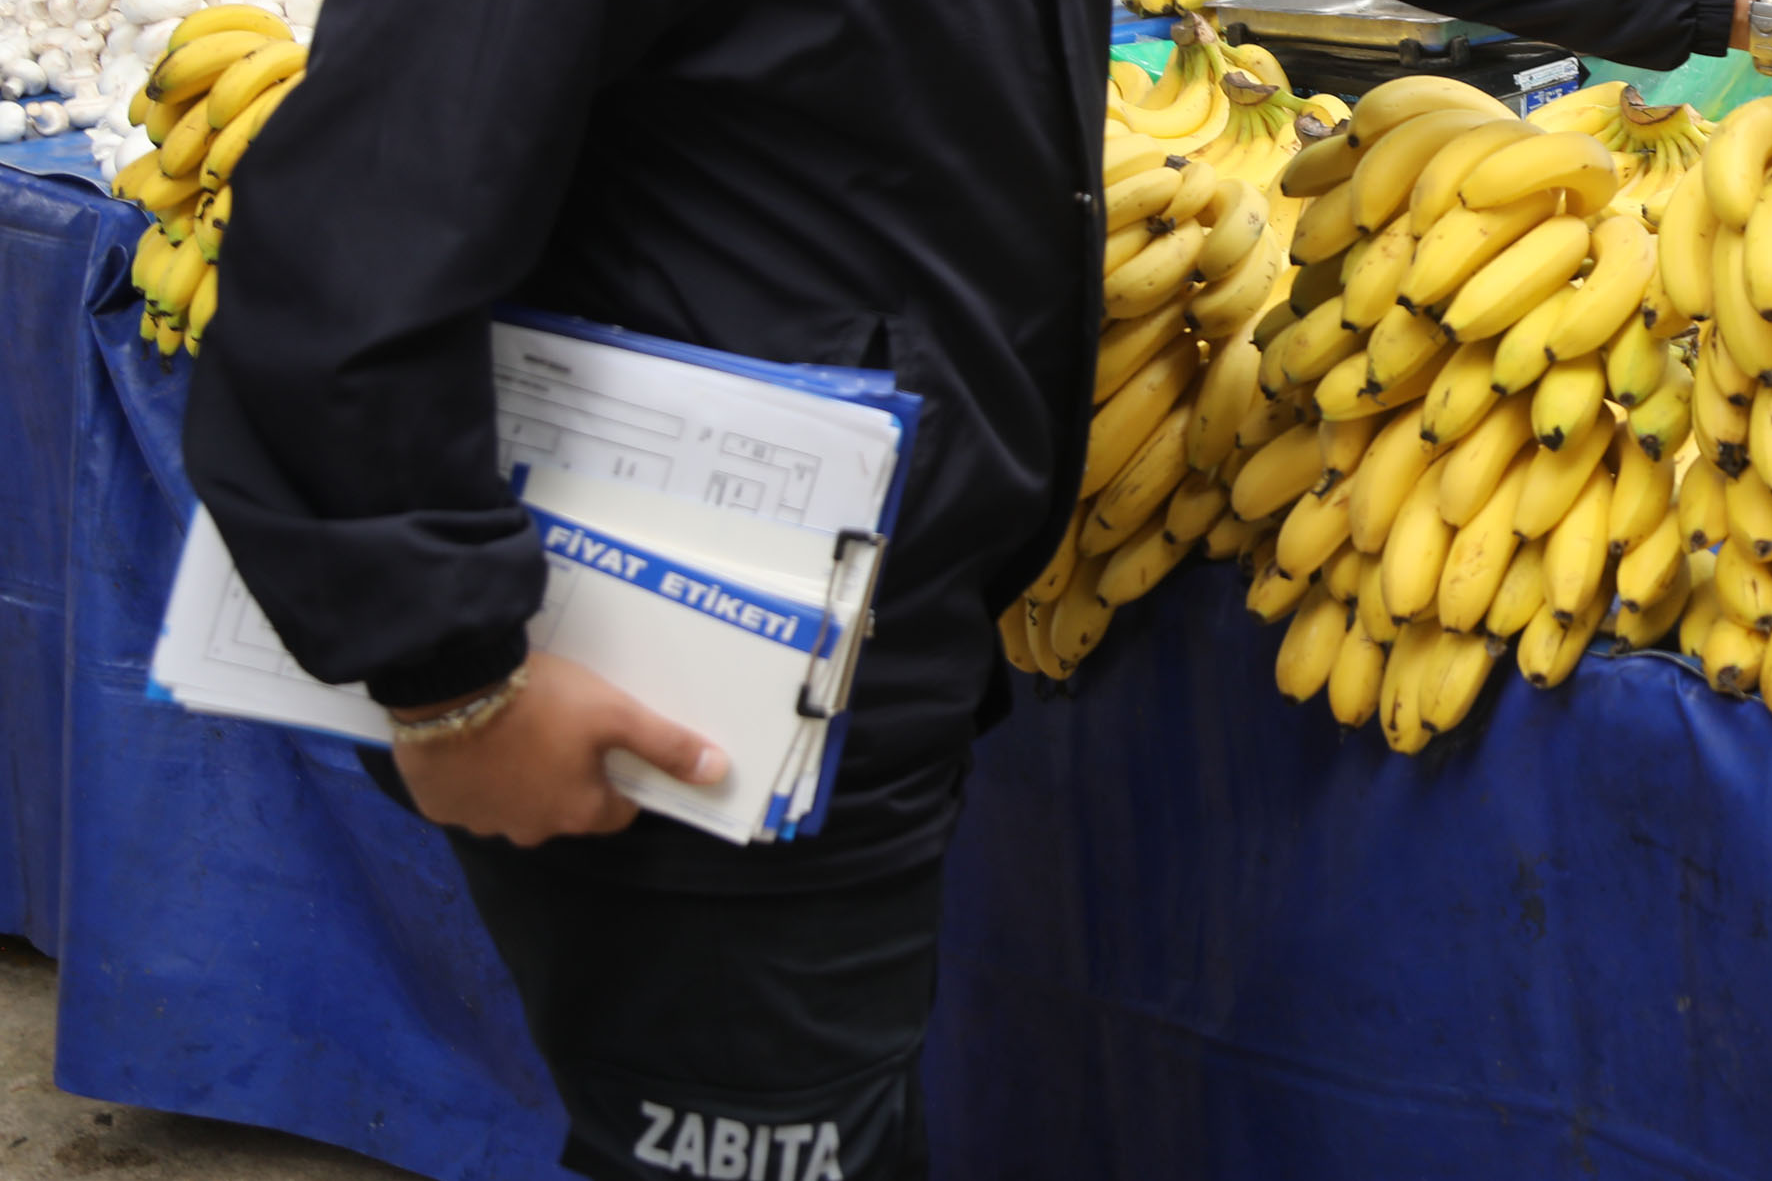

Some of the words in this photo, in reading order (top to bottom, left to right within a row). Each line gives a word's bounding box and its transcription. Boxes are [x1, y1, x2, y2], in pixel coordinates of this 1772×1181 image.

[546, 523, 648, 581] FİYAT
[658, 569, 799, 642] ETİKETİ
[634, 1099, 844, 1181] ZABITA
